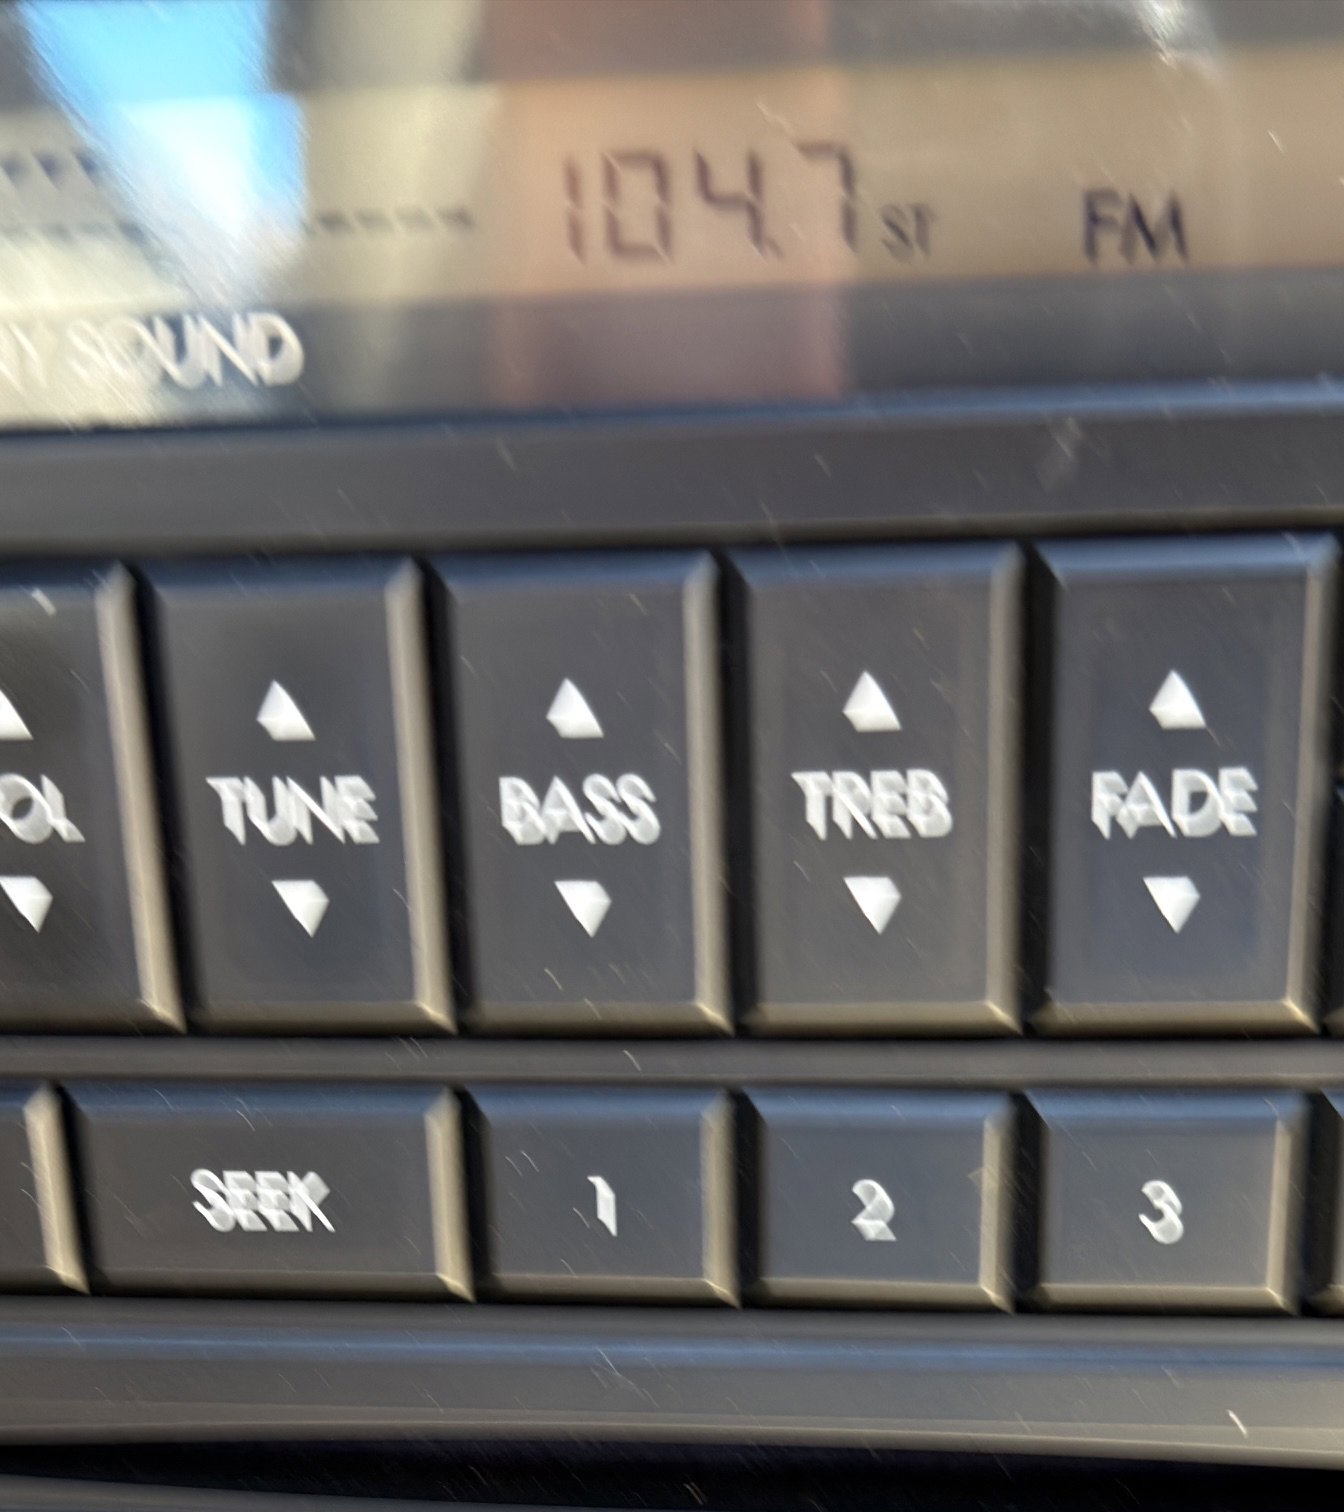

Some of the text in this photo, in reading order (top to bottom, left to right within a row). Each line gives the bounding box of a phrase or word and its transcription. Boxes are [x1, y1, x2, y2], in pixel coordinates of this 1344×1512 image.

[1082, 187, 1190, 265] FM
[67, 312, 306, 395] SOUND
[206, 774, 379, 846] TUNE
[498, 773, 660, 846] BASS
[791, 768, 954, 841] TREB
[1091, 766, 1258, 840] FADE
[190, 1168, 334, 1232] SEEK
[587, 1174, 618, 1237] 1
[851, 1178, 896, 1242] 2
[1138, 1179, 1184, 1245] 3
